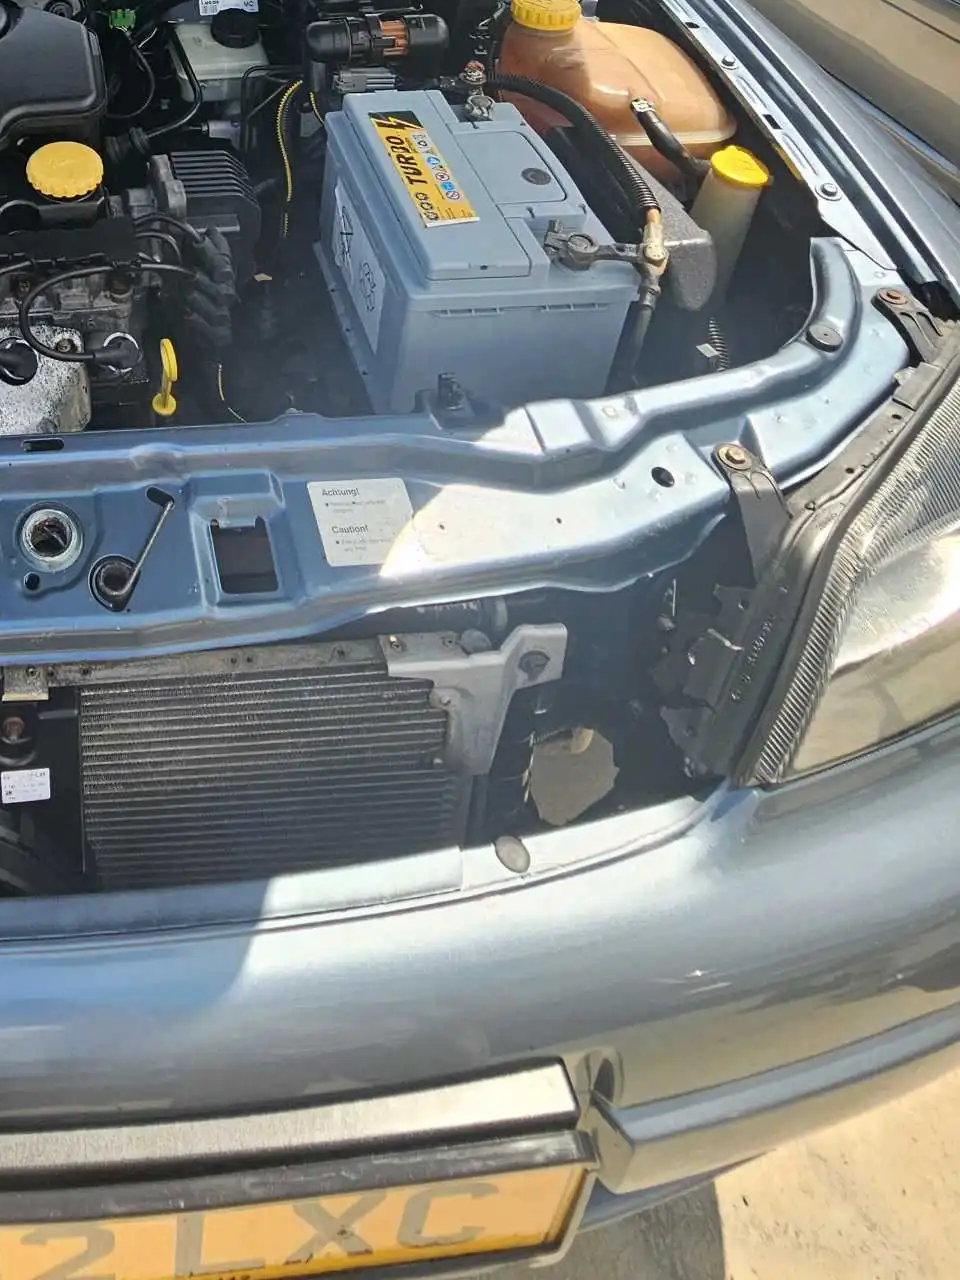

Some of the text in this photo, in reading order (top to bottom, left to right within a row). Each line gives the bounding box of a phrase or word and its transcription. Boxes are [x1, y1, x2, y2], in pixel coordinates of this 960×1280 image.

[386, 135, 428, 186] TURBO
[322, 487, 360, 497] Achtung!
[331, 524, 369, 534] Caution!
[174, 1182, 500, 1277] LXC
